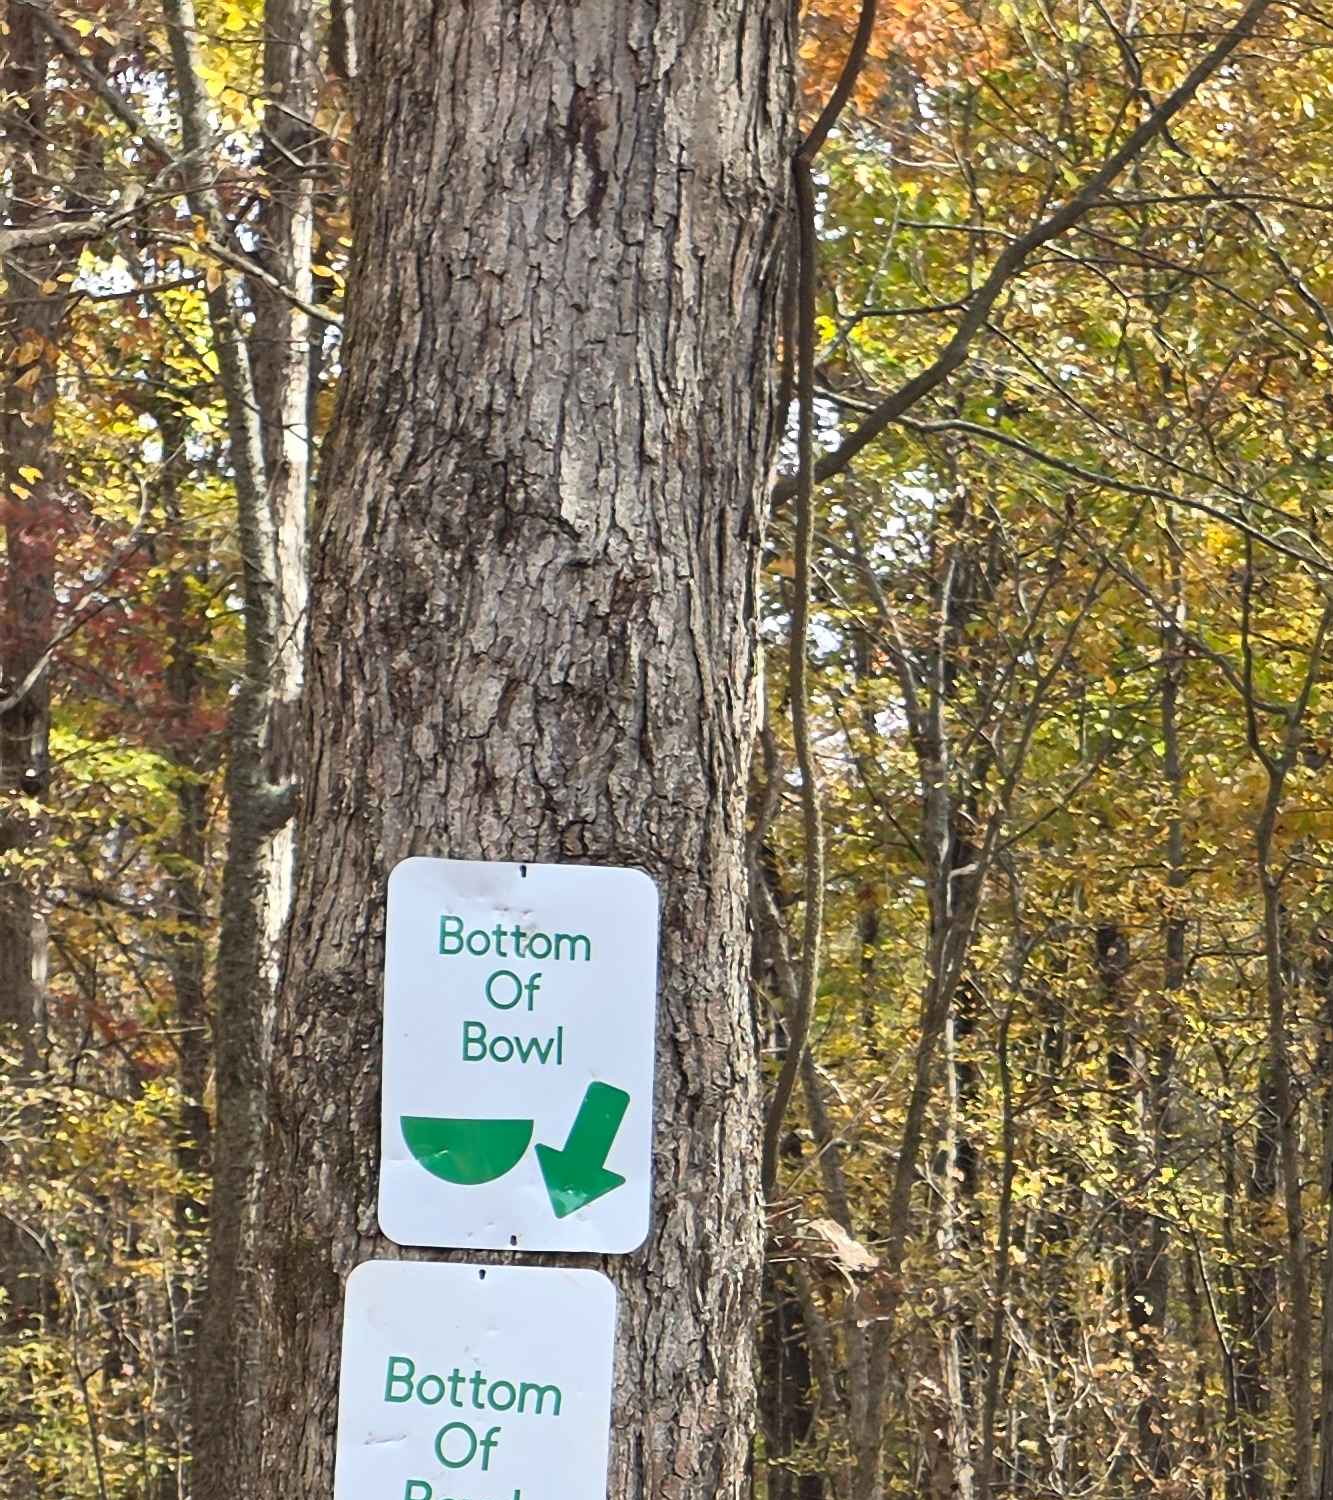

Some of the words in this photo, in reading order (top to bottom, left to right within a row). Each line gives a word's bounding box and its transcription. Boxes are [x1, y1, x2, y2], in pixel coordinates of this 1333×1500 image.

[438, 914, 591, 962] Bottom
[485, 969, 542, 1011] Of
[462, 1020, 563, 1066] Bowl
[384, 1355, 562, 1416] Bottom
[434, 1421, 501, 1471] Of
